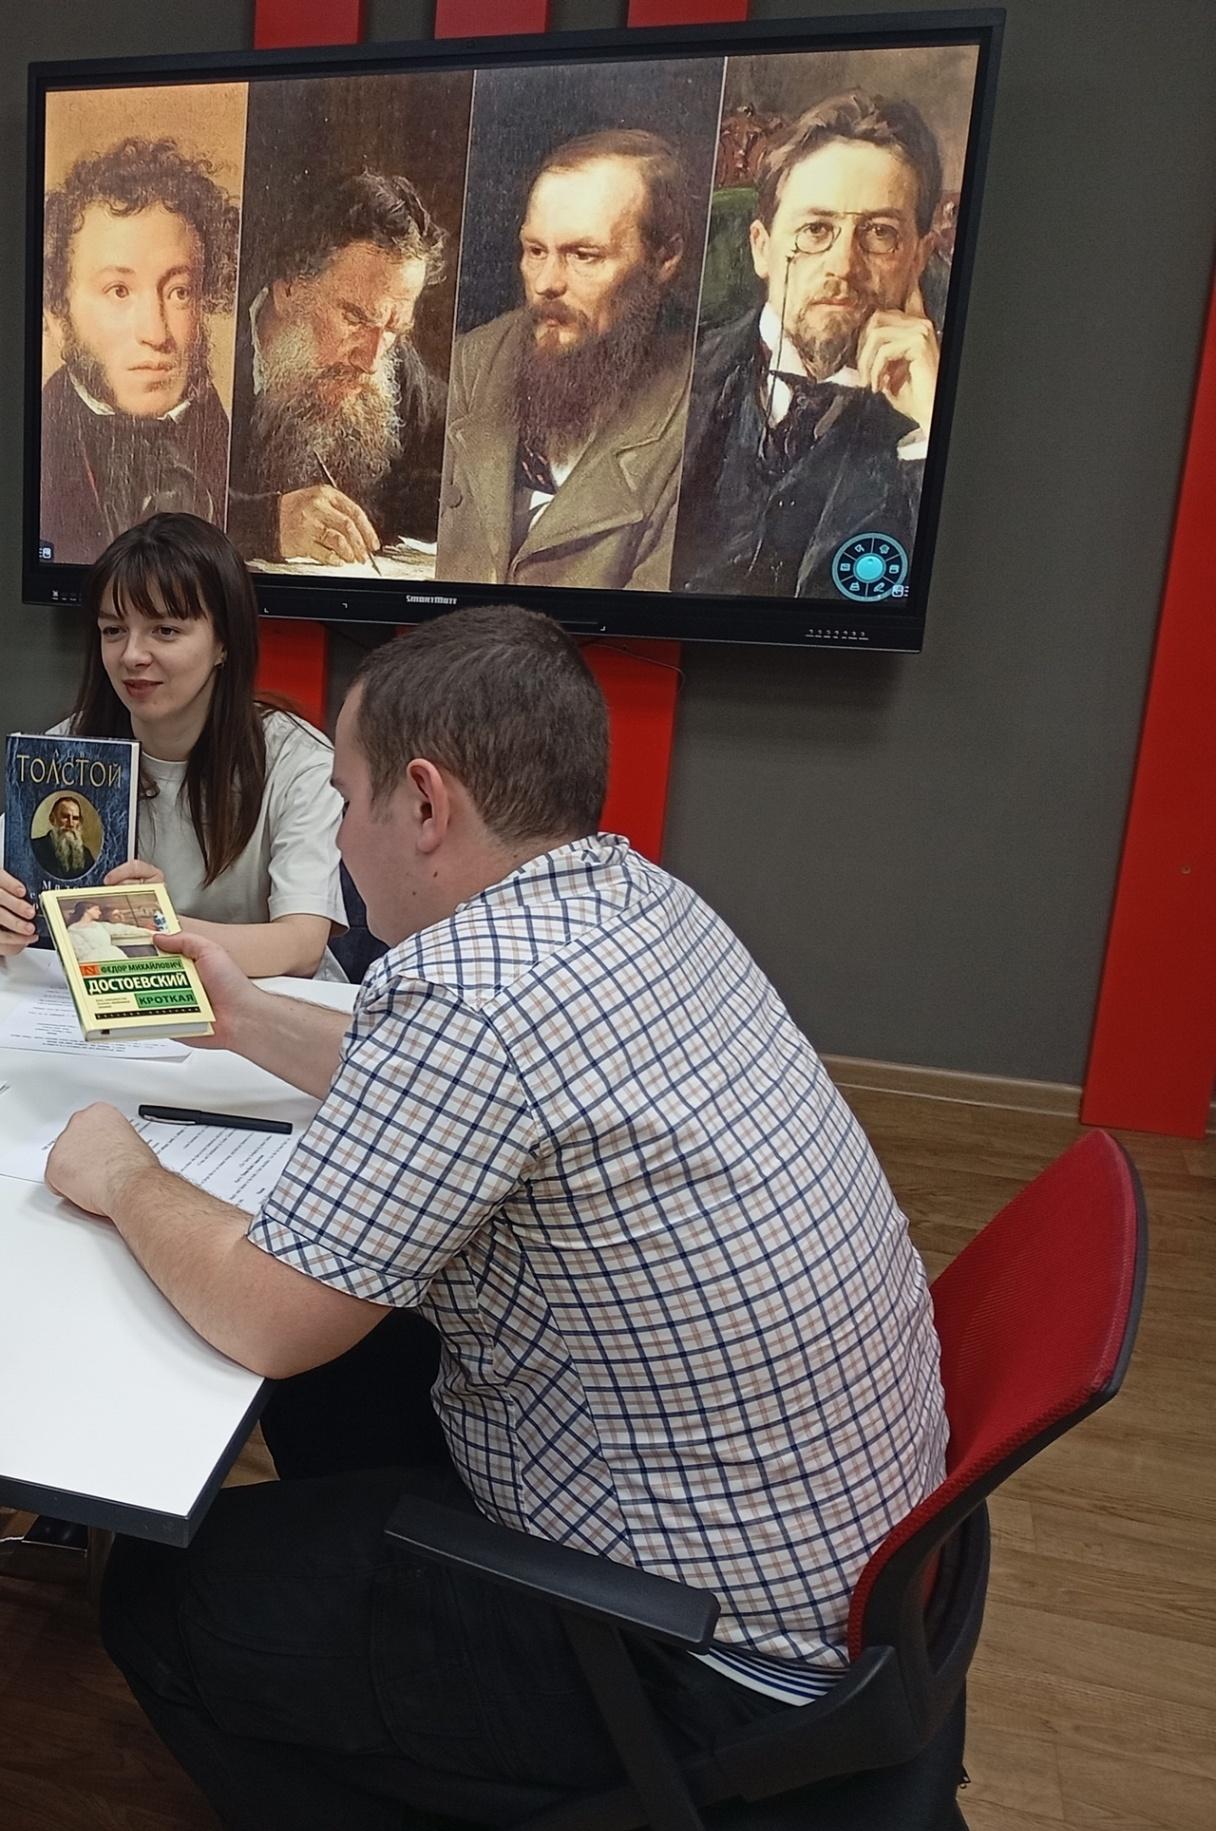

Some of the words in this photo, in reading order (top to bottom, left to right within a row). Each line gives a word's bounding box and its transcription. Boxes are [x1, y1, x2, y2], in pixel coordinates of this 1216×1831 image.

[16, 754, 122, 788] ТОЛСТОЙ
[100, 964, 127, 975] ФЕДОР
[128, 960, 183, 973] МИХАЙЛОВИЧ
[89, 973, 189, 995] ДОСТОЕВСКИЙ
[138, 993, 194, 1006] КРОТКАЯ
